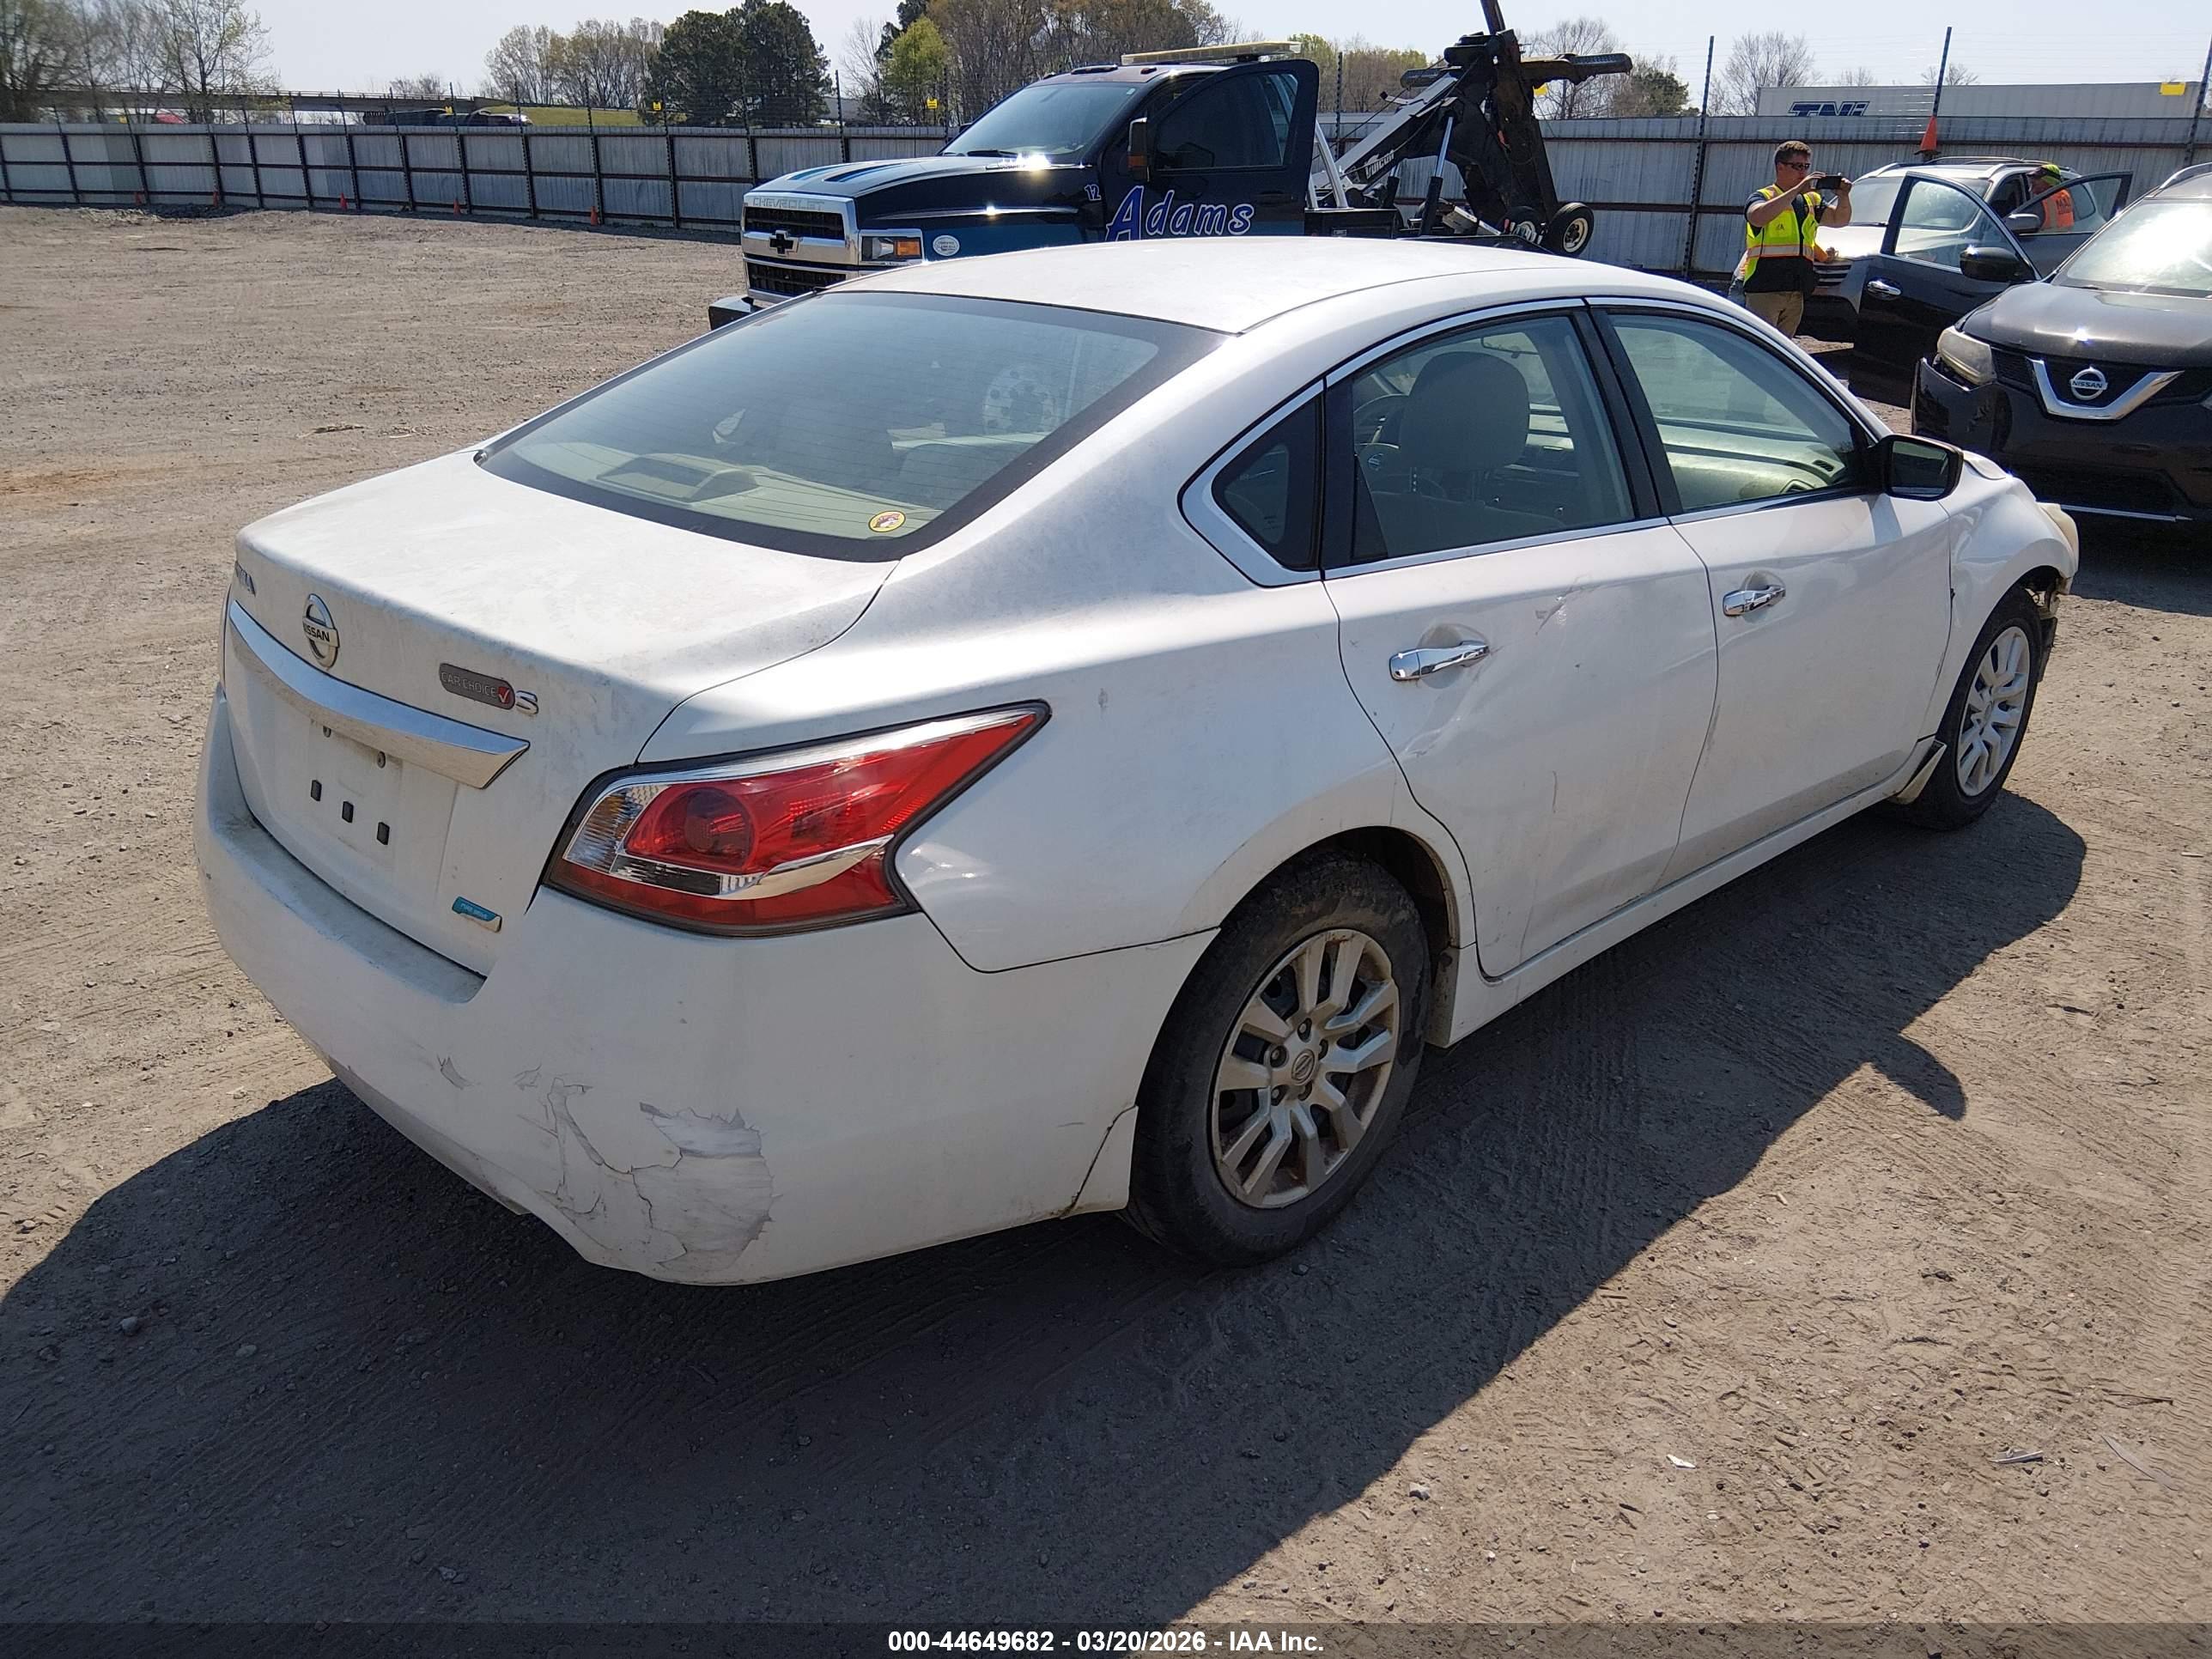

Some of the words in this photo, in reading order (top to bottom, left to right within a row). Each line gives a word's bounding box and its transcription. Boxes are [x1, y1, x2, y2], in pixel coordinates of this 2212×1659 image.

[1085, 184, 1102, 201] 12
[752, 197, 825, 211] CHEVROLET
[1105, 185, 1255, 241] Adams
[2071, 380, 2103, 389] NISSAN
[441, 672, 461, 686] CAR
[463, 678, 497, 697] CHOICE
[515, 690, 539, 716] S
